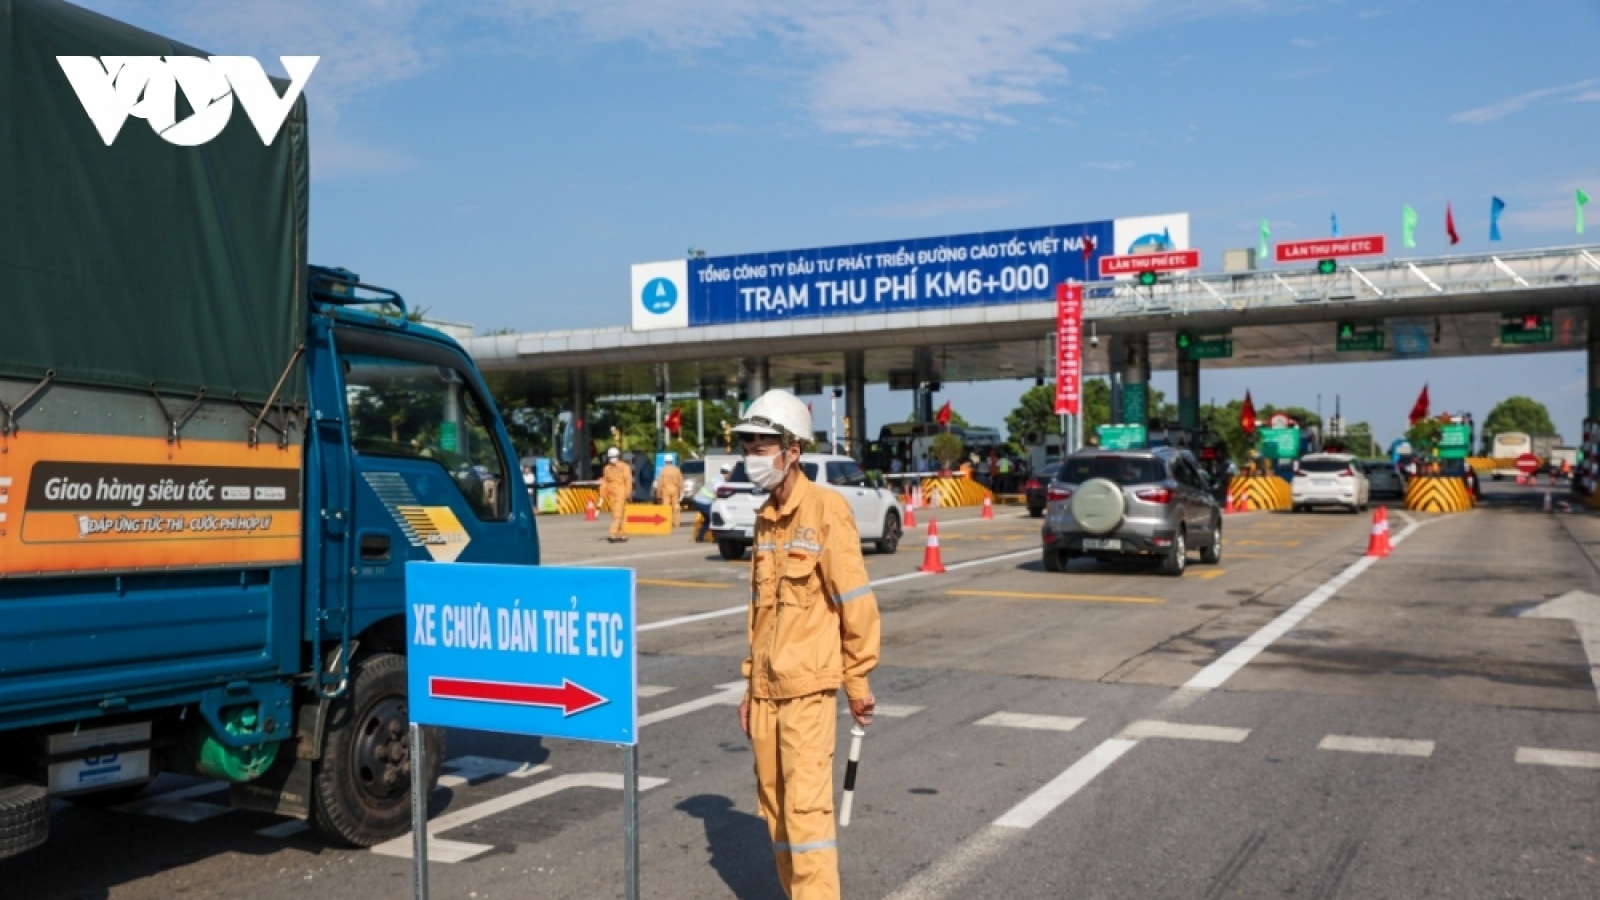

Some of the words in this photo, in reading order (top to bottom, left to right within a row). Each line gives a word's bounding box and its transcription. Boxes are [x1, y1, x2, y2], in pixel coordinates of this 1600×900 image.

[698, 264, 731, 283] TỔNG
[733, 263, 767, 280] CÔNG
[769, 263, 785, 277] TY
[788, 256, 814, 275] ĐẦU
[816, 257, 834, 273] TƯ
[837, 253, 872, 272] PHÁT
[875, 246, 915, 268] TRIỂN
[918, 245, 967, 264] ĐƯỜNG
[1028, 237, 1059, 257] VIỆT
[1131, 257, 1149, 270] THU
[1168, 254, 1187, 266] ETC
[1310, 244, 1331, 256] THU
[1351, 240, 1371, 253] ETC
[740, 282, 809, 314] TRẠM
[815, 278, 867, 307] THU
[874, 267, 919, 302] PHÍ
[925, 263, 1049, 298] KM6+000
[44, 477, 93, 501] Giao
[95, 478, 143, 507] hàng
[147, 478, 185, 501] siêu
[187, 478, 216, 501] tốc
[412, 603, 437, 646] XE
[441, 602, 493, 650] CHƯA
[497, 598, 538, 653] DÁN
[543, 595, 580, 656] THẺ
[586, 612, 624, 659] ETC
